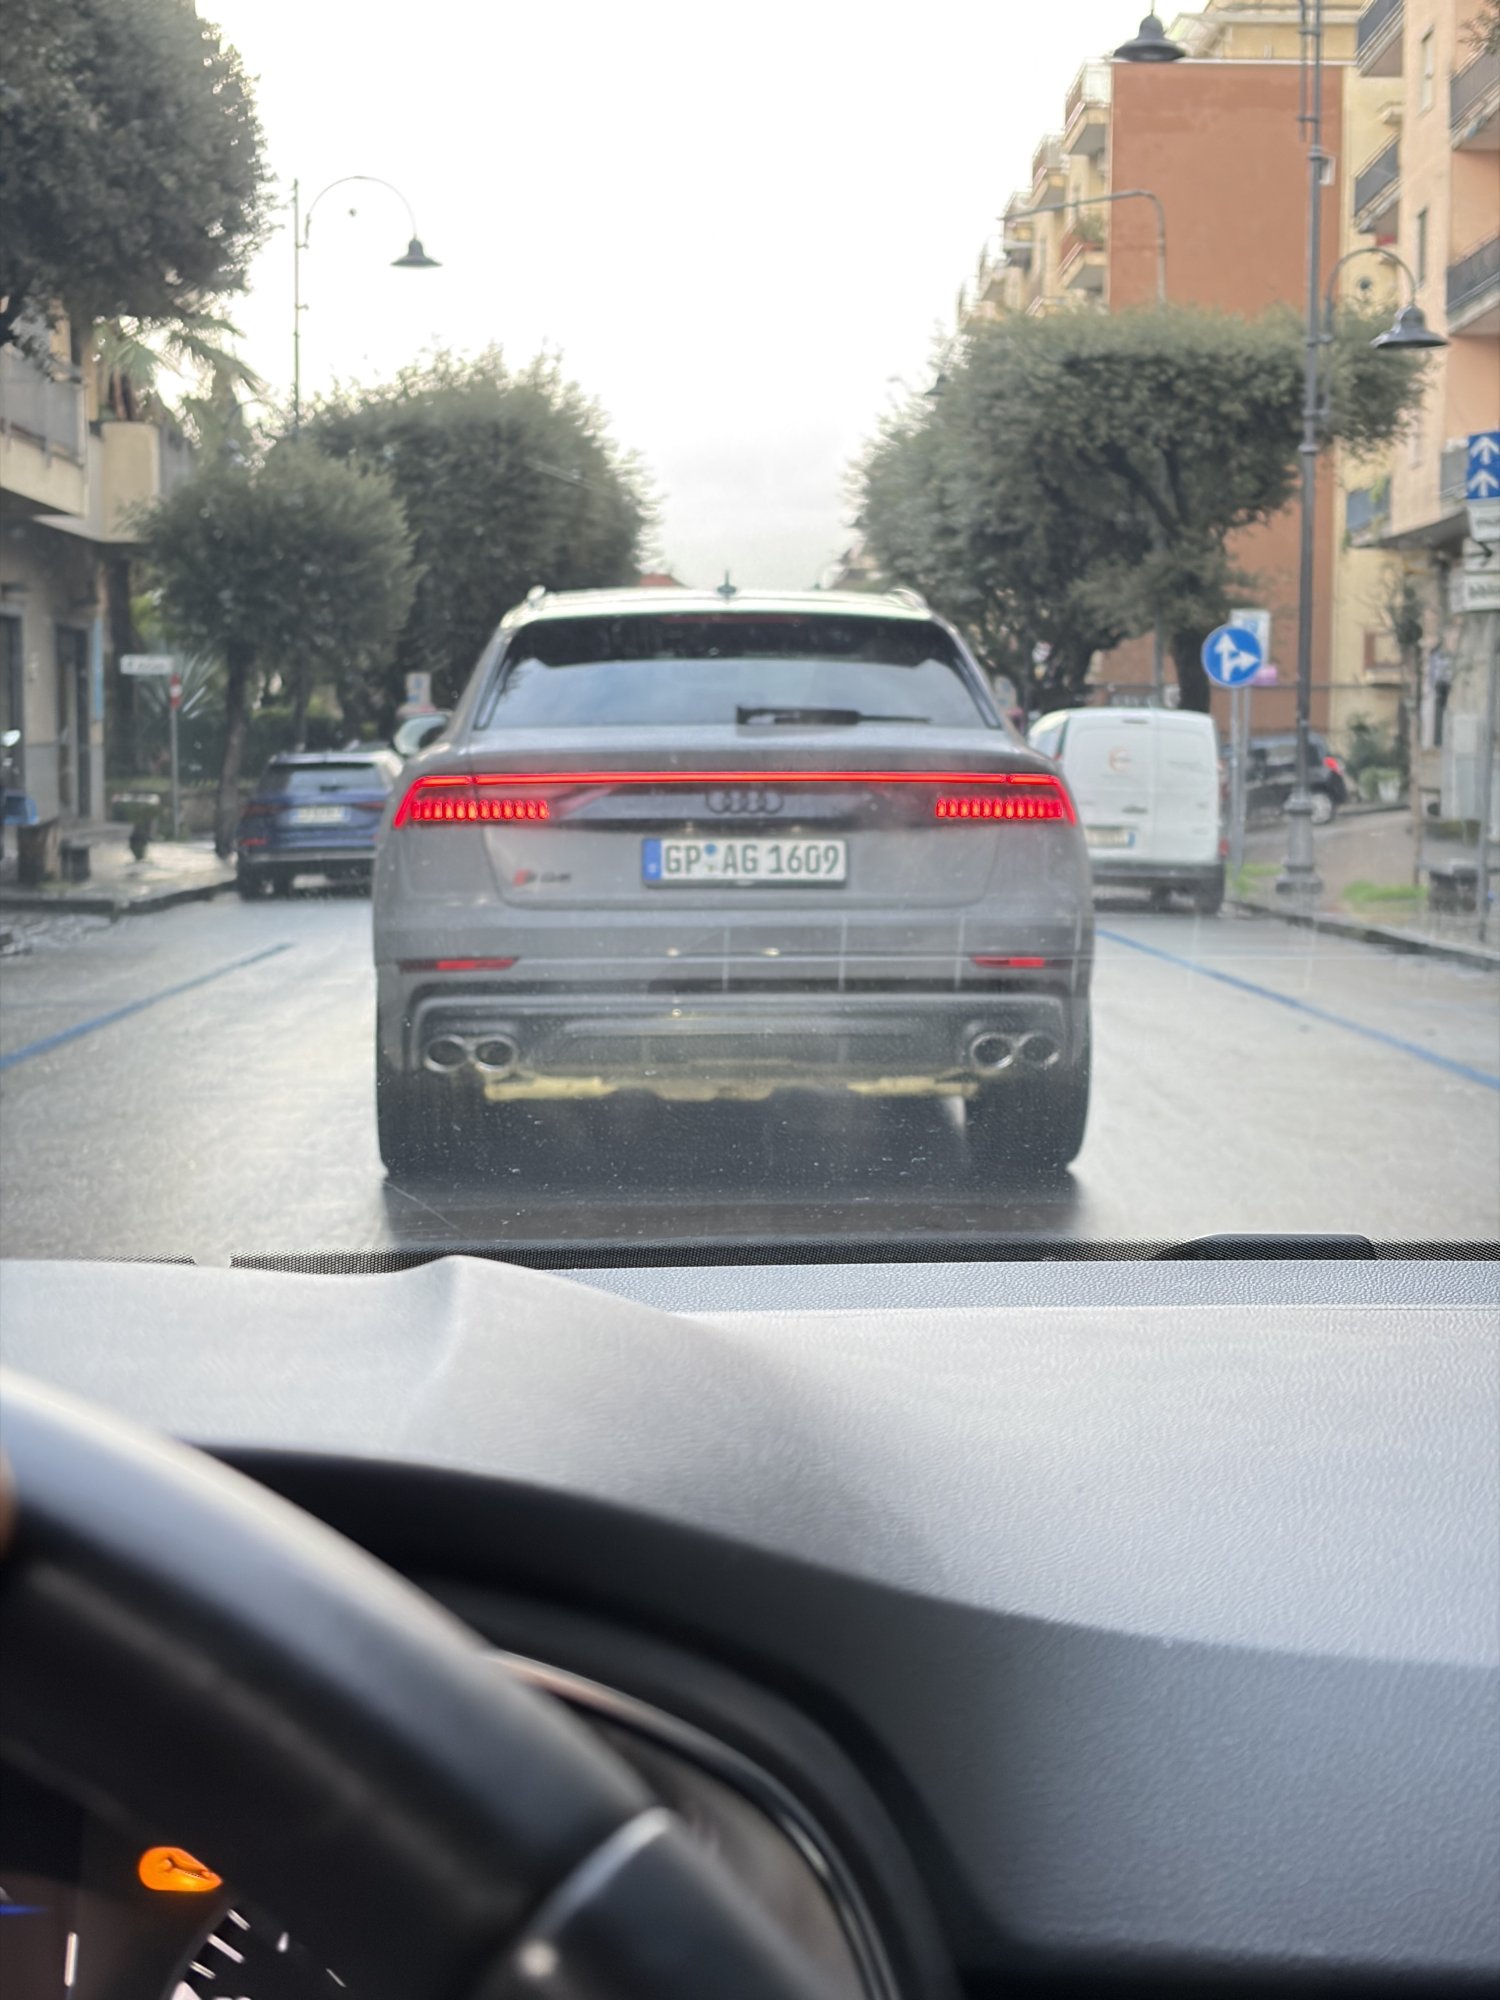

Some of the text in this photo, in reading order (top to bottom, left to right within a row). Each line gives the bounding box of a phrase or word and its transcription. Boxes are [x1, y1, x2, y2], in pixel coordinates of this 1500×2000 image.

[665, 843, 840, 874] GP AG 1609
